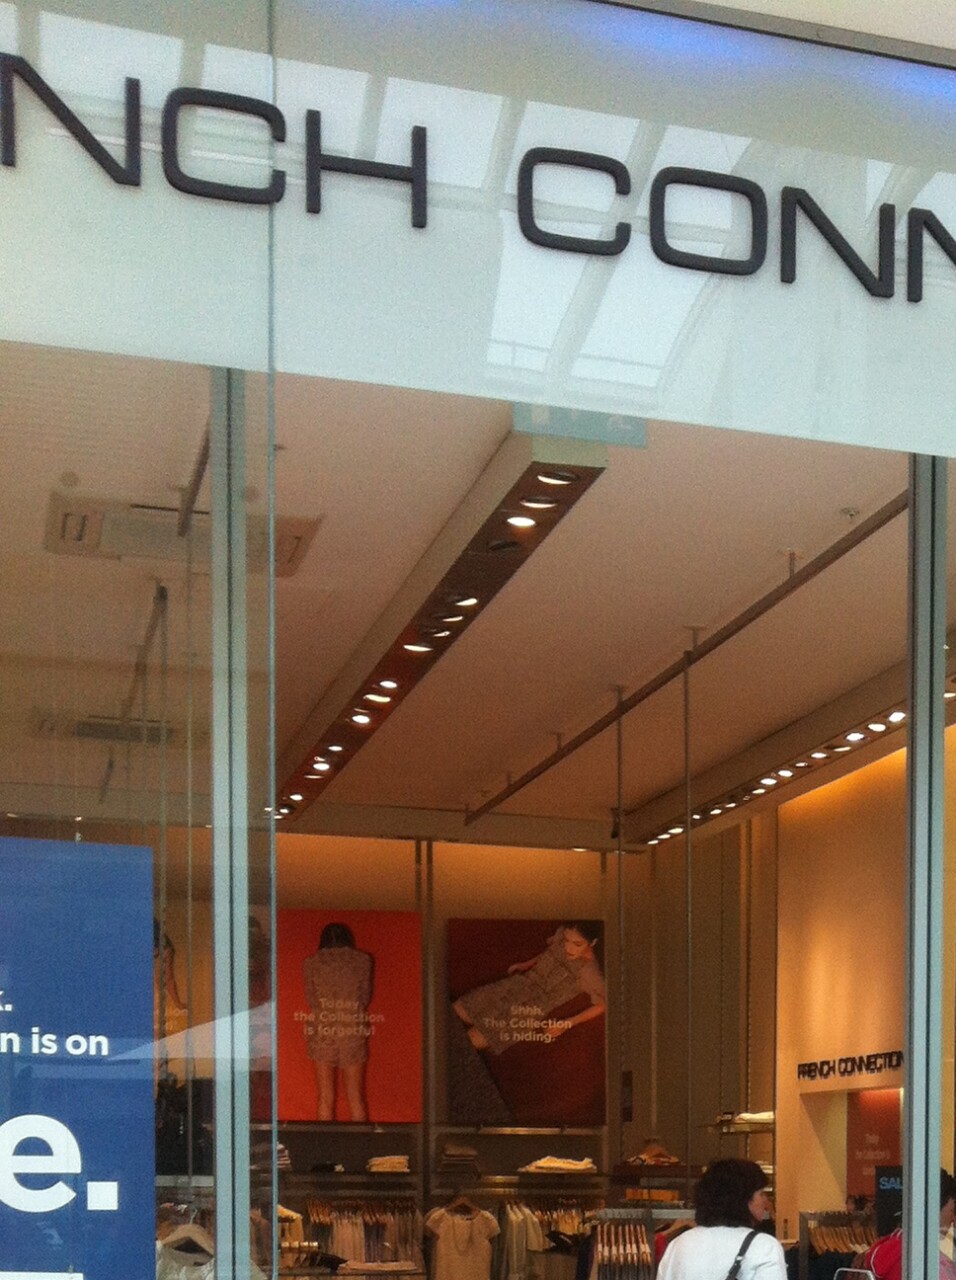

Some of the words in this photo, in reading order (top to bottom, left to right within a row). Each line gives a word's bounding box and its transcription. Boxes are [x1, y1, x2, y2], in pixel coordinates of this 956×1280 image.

[0, 53, 428, 229] NCH
[510, 1017, 572, 1029] Collection
[31, 1026, 58, 1055] is
[65, 1034, 109, 1056] on
[513, 1031, 556, 1044] hiding.
[798, 1060, 836, 1080] FRENCH
